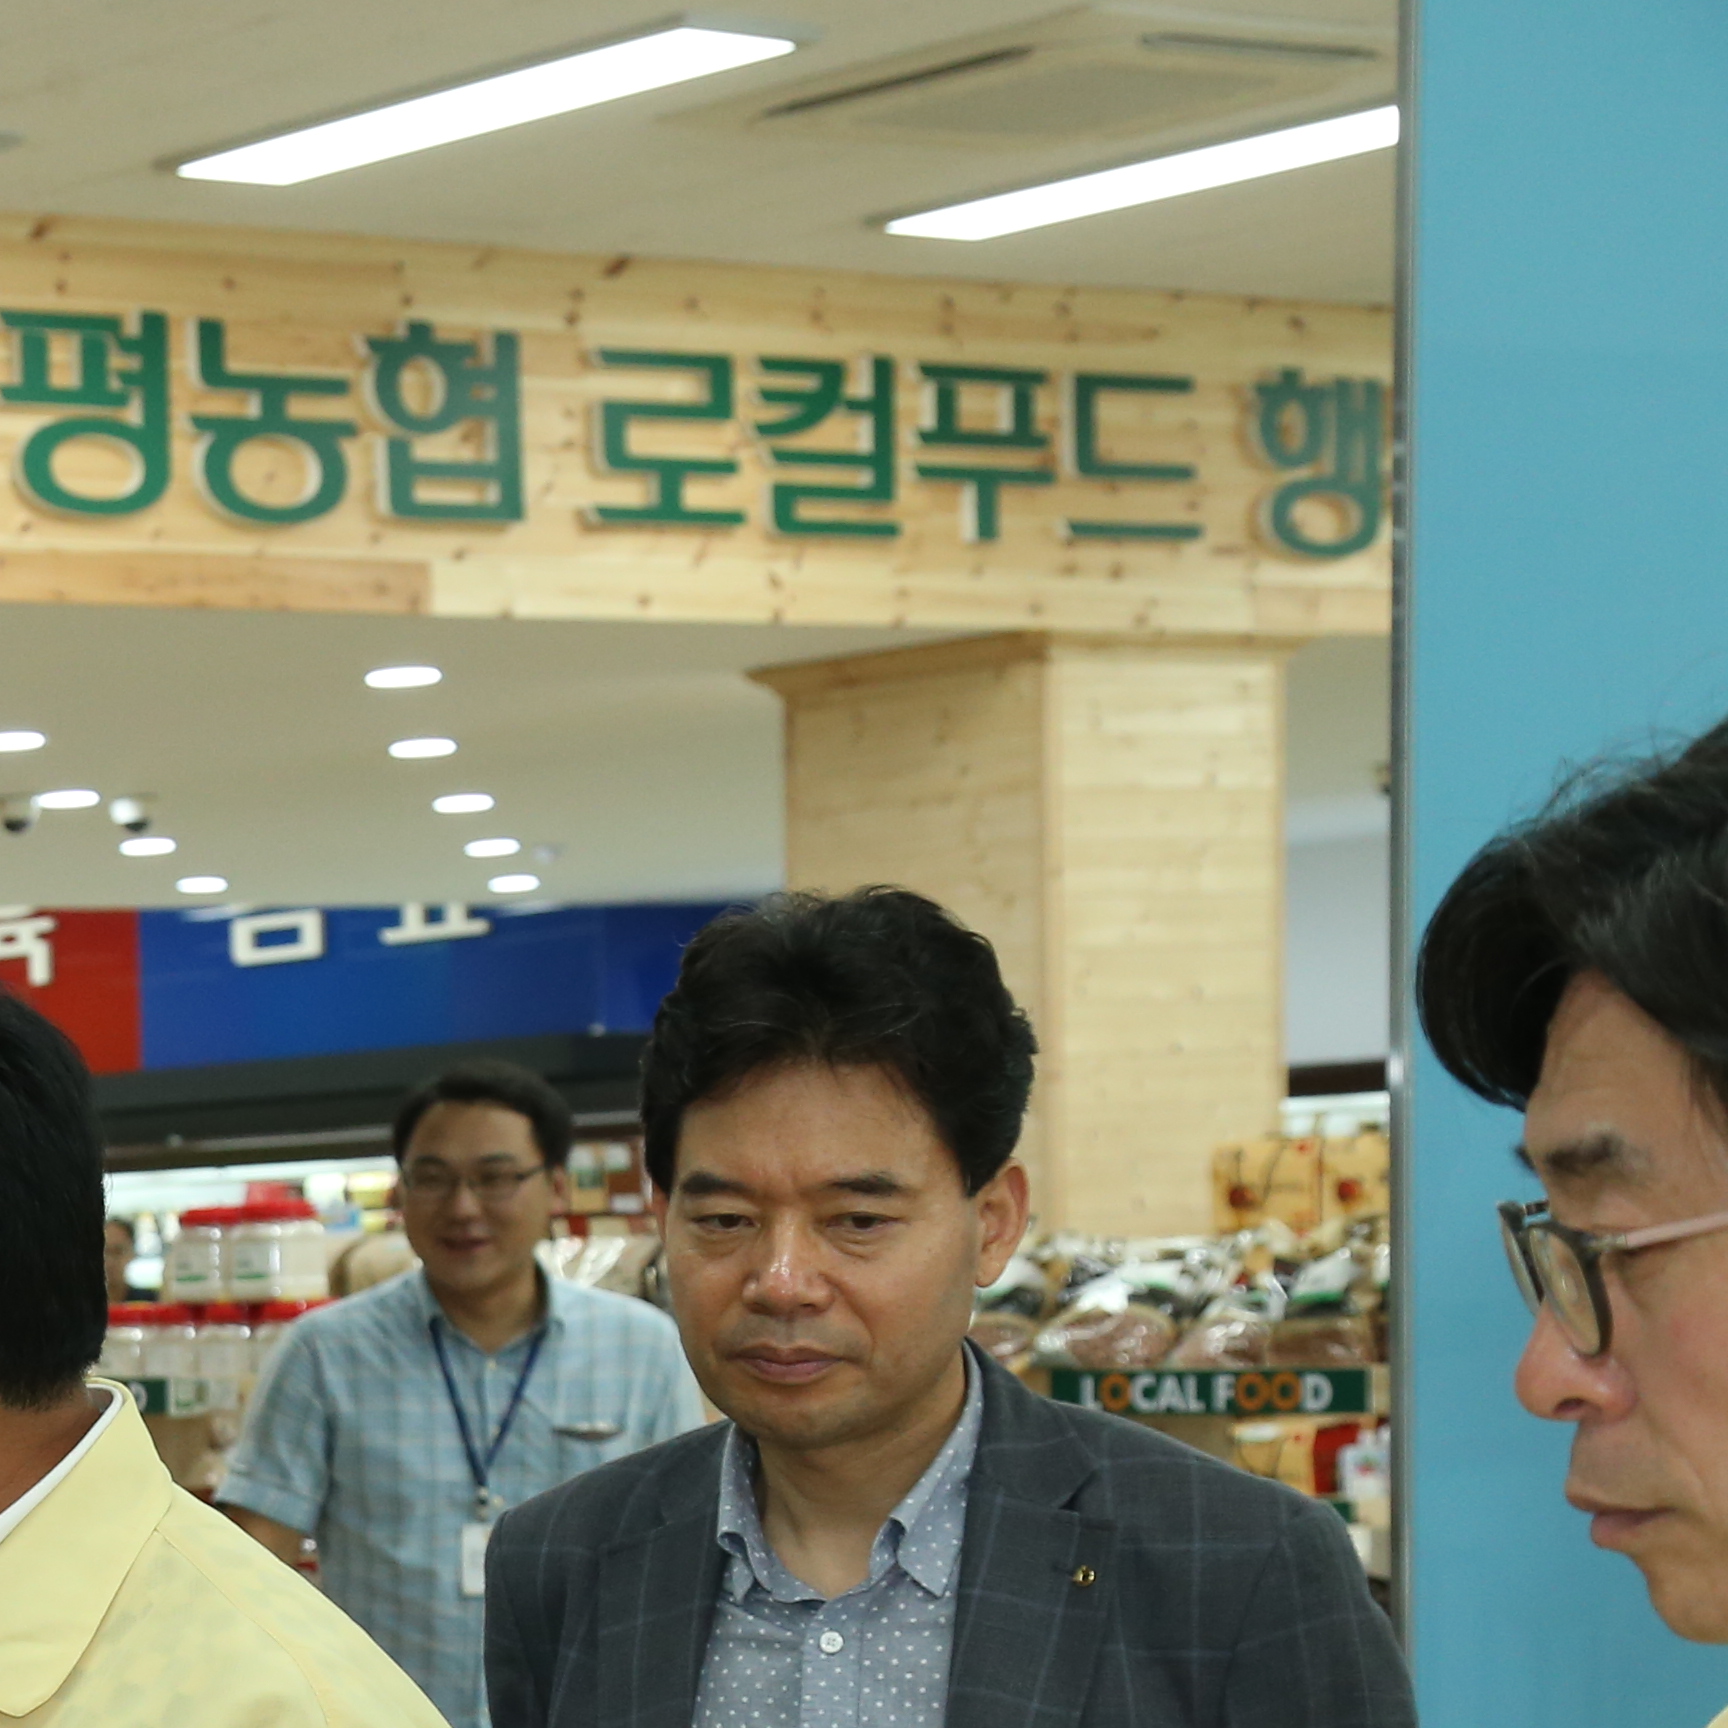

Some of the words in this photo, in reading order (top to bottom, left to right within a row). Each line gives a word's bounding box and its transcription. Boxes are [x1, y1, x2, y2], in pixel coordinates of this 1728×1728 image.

[580, 346, 1204, 542] 로컬푸드
[1079, 1373, 1207, 1413] LOCAL
[1211, 1372, 1334, 1411] FOOD
